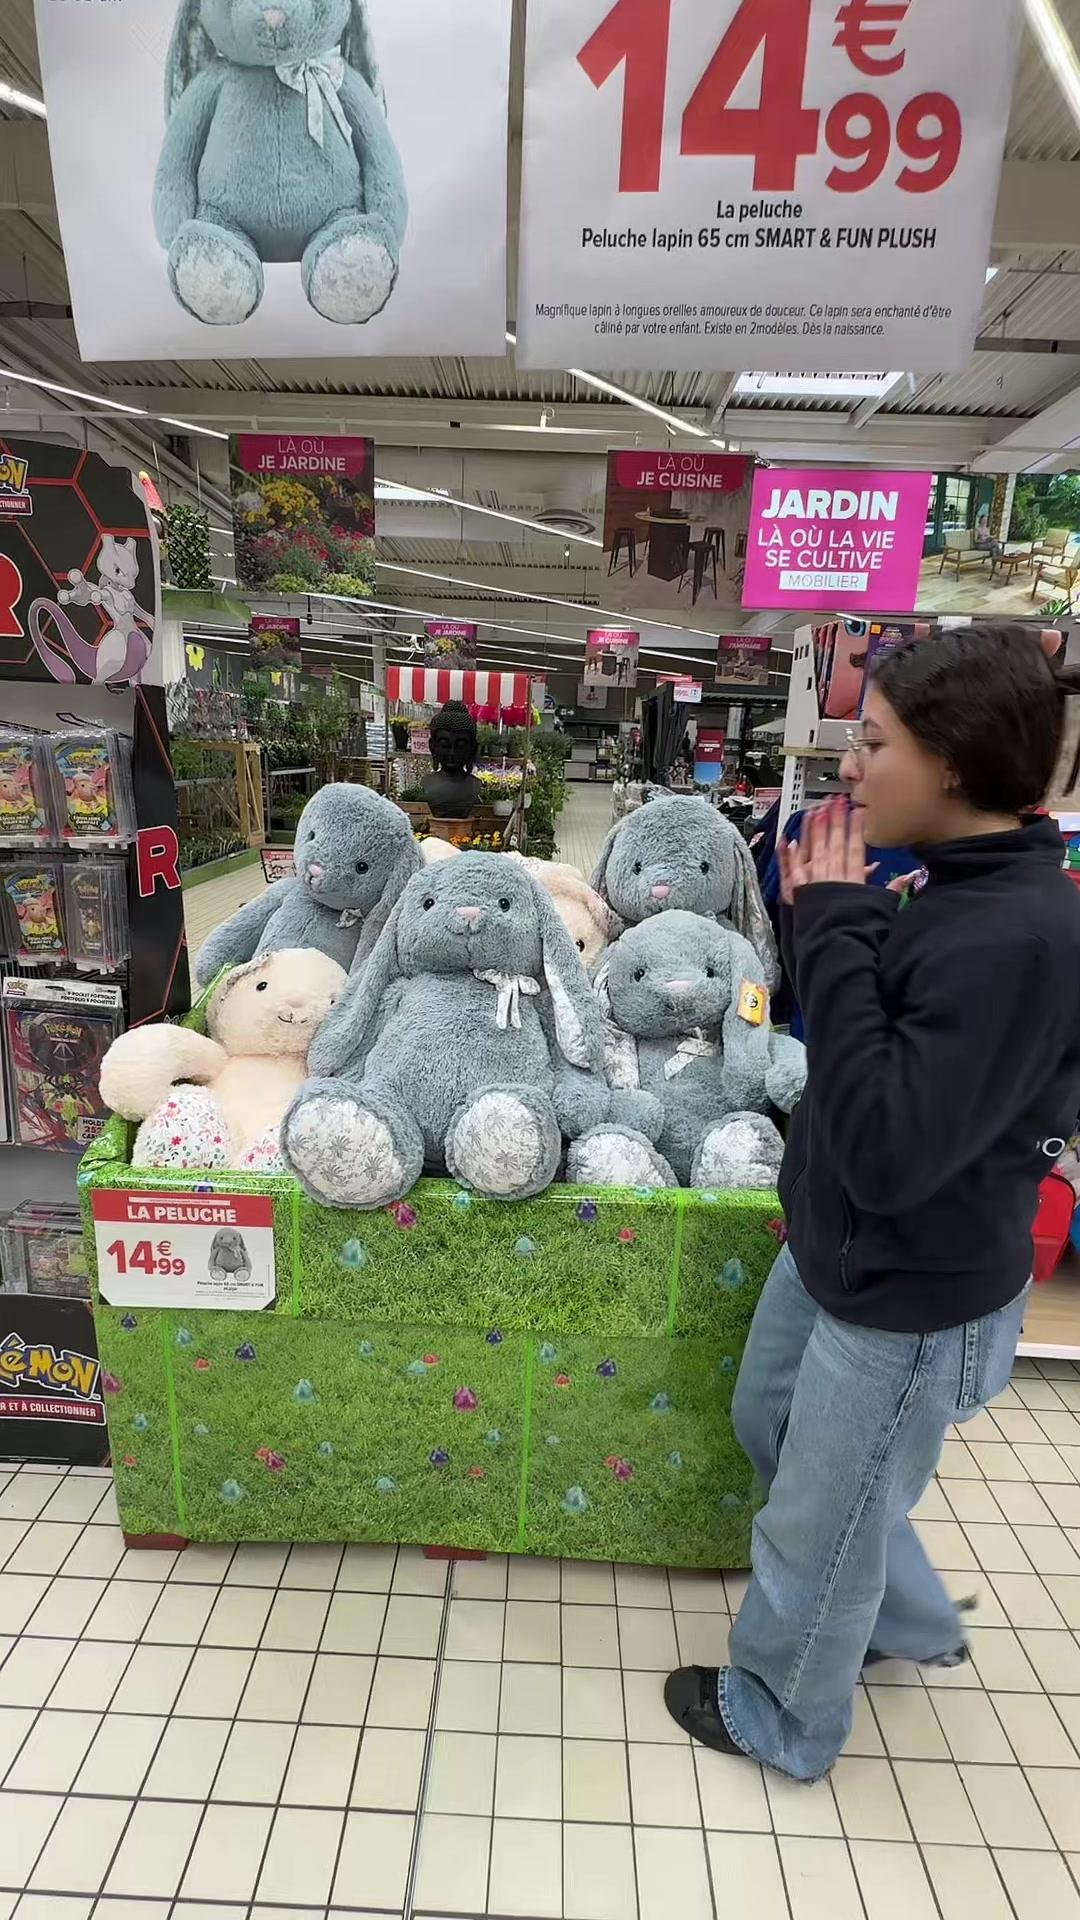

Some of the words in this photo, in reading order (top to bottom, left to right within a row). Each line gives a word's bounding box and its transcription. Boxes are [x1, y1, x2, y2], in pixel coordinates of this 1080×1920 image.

[716, 200, 734, 219] La
[739, 199, 802, 222] peluche
[582, 228, 647, 248] Peluche
[652, 228, 692, 251] lapin
[698, 228, 720, 248] 65
[725, 232, 749, 248] cm
[755, 228, 816, 248] SMART
[819, 228, 831, 248] &
[836, 228, 873, 248] FUN
[877, 228, 937, 249] PLUSH
[535, 304, 587, 319] Magnifique
[589, 304, 612, 319] lapin
[614, 303, 620, 317] à
[622, 304, 661, 319] longues
[662, 304, 697, 317] oreilles
[700, 306, 747, 317] amoureux
[750, 304, 762, 317] de
[765, 304, 806, 317] douceur.
[809, 304, 823, 317] Ce
[824, 304, 848, 319] lapin
[851, 306, 872, 317] sera
[875, 304, 920, 318] enchanté
[923, 304, 952, 318] d'être
[594, 320, 622, 334] câliné
[625, 322, 640, 336] par
[642, 322, 667, 334] votre
[669, 321, 701, 334] enfant.
[704, 321, 732, 335] Existe
[735, 324, 747, 335] en
[802, 321, 821, 335] Dès
[823, 322, 831, 335] la
[834, 323, 885, 336] naissance.
[278, 436, 297, 453] LÀ
[301, 437, 324, 454] OÙ
[258, 455, 275, 469] JE
[279, 455, 346, 471] JARDINE
[657, 453, 676, 470] LÀ
[681, 455, 704, 471] OÙ
[637, 472, 654, 485] JE
[659, 472, 722, 488] CUISINE
[761, 489, 899, 521] JARDIN
[758, 524, 783, 547] LÀ
[790, 525, 823, 547] OÙ
[829, 529, 854, 548] LA
[862, 530, 895, 549] VIE
[765, 549, 791, 567] SE
[797, 550, 883, 570] CULTIVE
[788, 574, 859, 588] MOBILIER
[127, 1205, 151, 1220] LA
[154, 1206, 237, 1223] PELUCHE
[9, 1402, 18, 1411] ET
[21, 1400, 28, 1411] À
[28, 1402, 96, 1417] COLLECTIONNER
